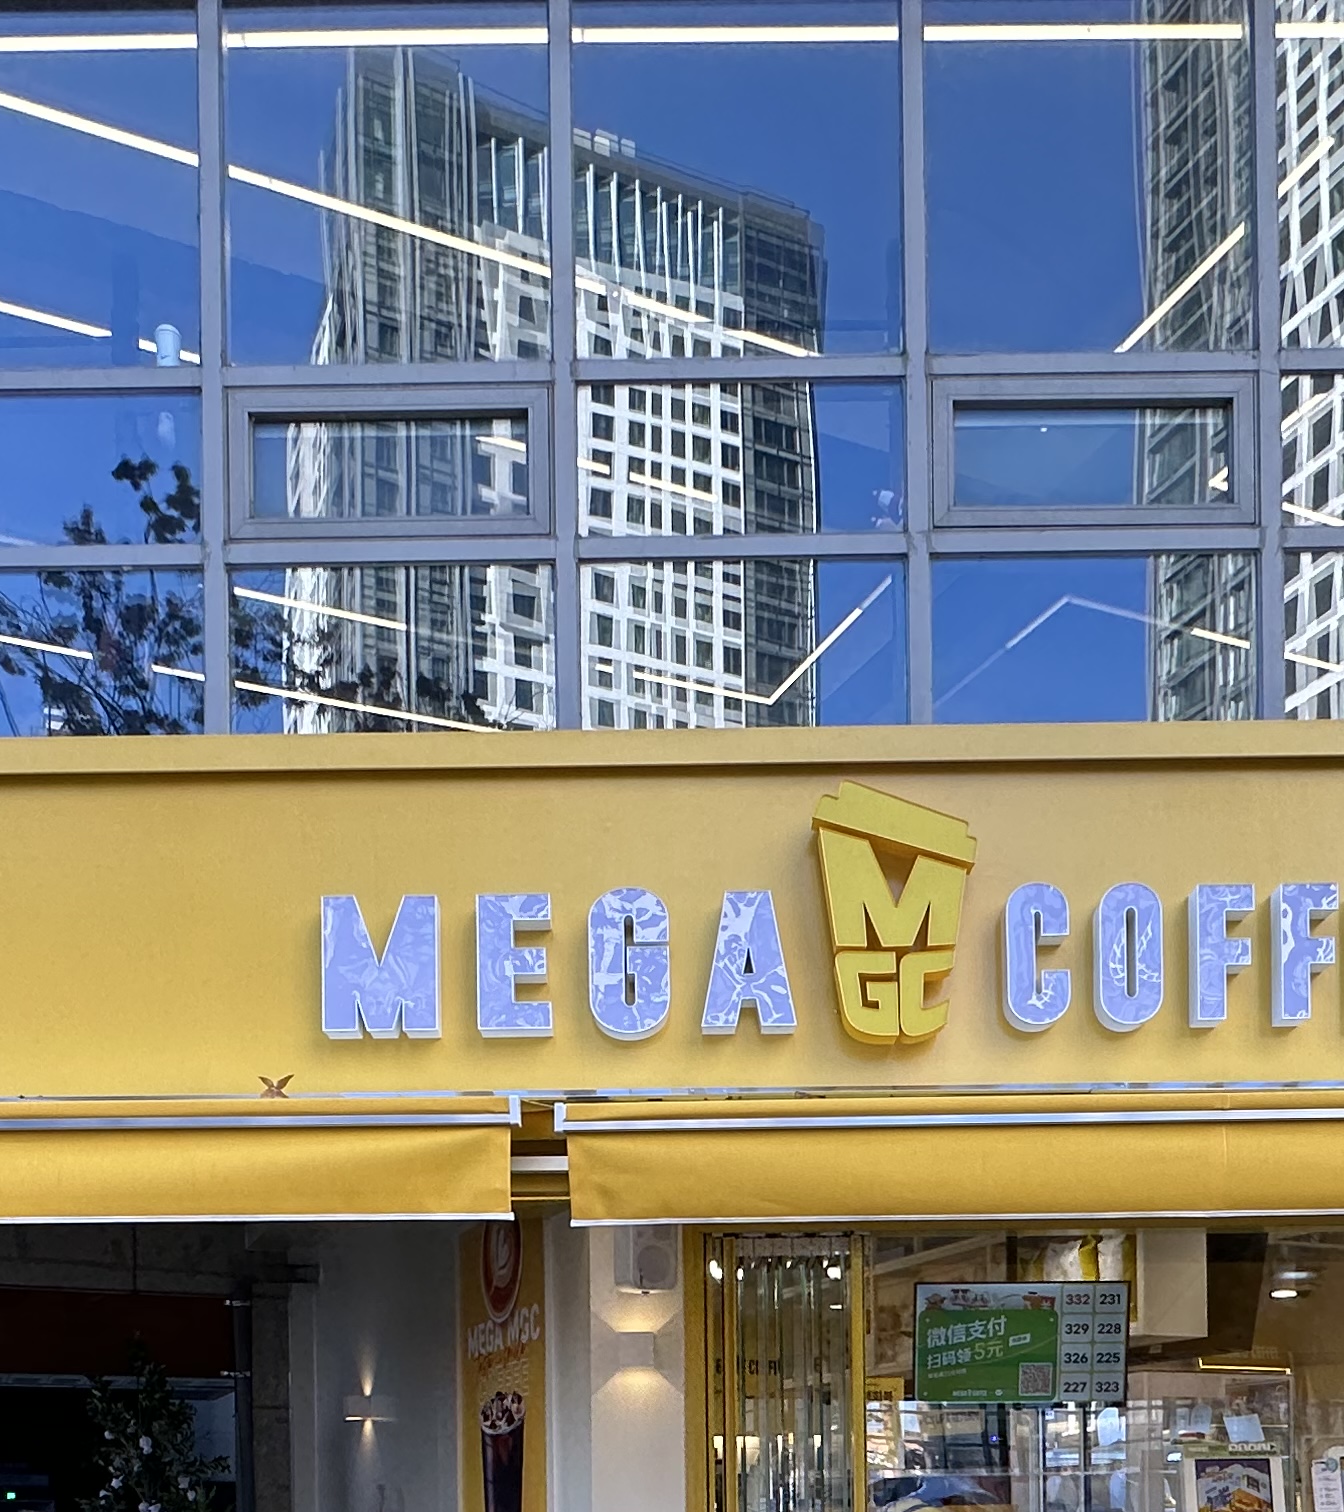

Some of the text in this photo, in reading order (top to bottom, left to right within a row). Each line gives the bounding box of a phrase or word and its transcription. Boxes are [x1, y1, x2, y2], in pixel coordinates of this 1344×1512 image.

[320, 888, 798, 1041] MEGA
[1065, 1293, 1121, 1305] 332 231
[927, 1315, 1007, 1349] 微信支付
[1064, 1323, 1122, 1335] 329 228
[466, 1326, 503, 1360] MEGA
[927, 1339, 1004, 1370] 扫码领5元
[1063, 1352, 1121, 1364] 326 225
[1063, 1381, 1119, 1393] 227 323
